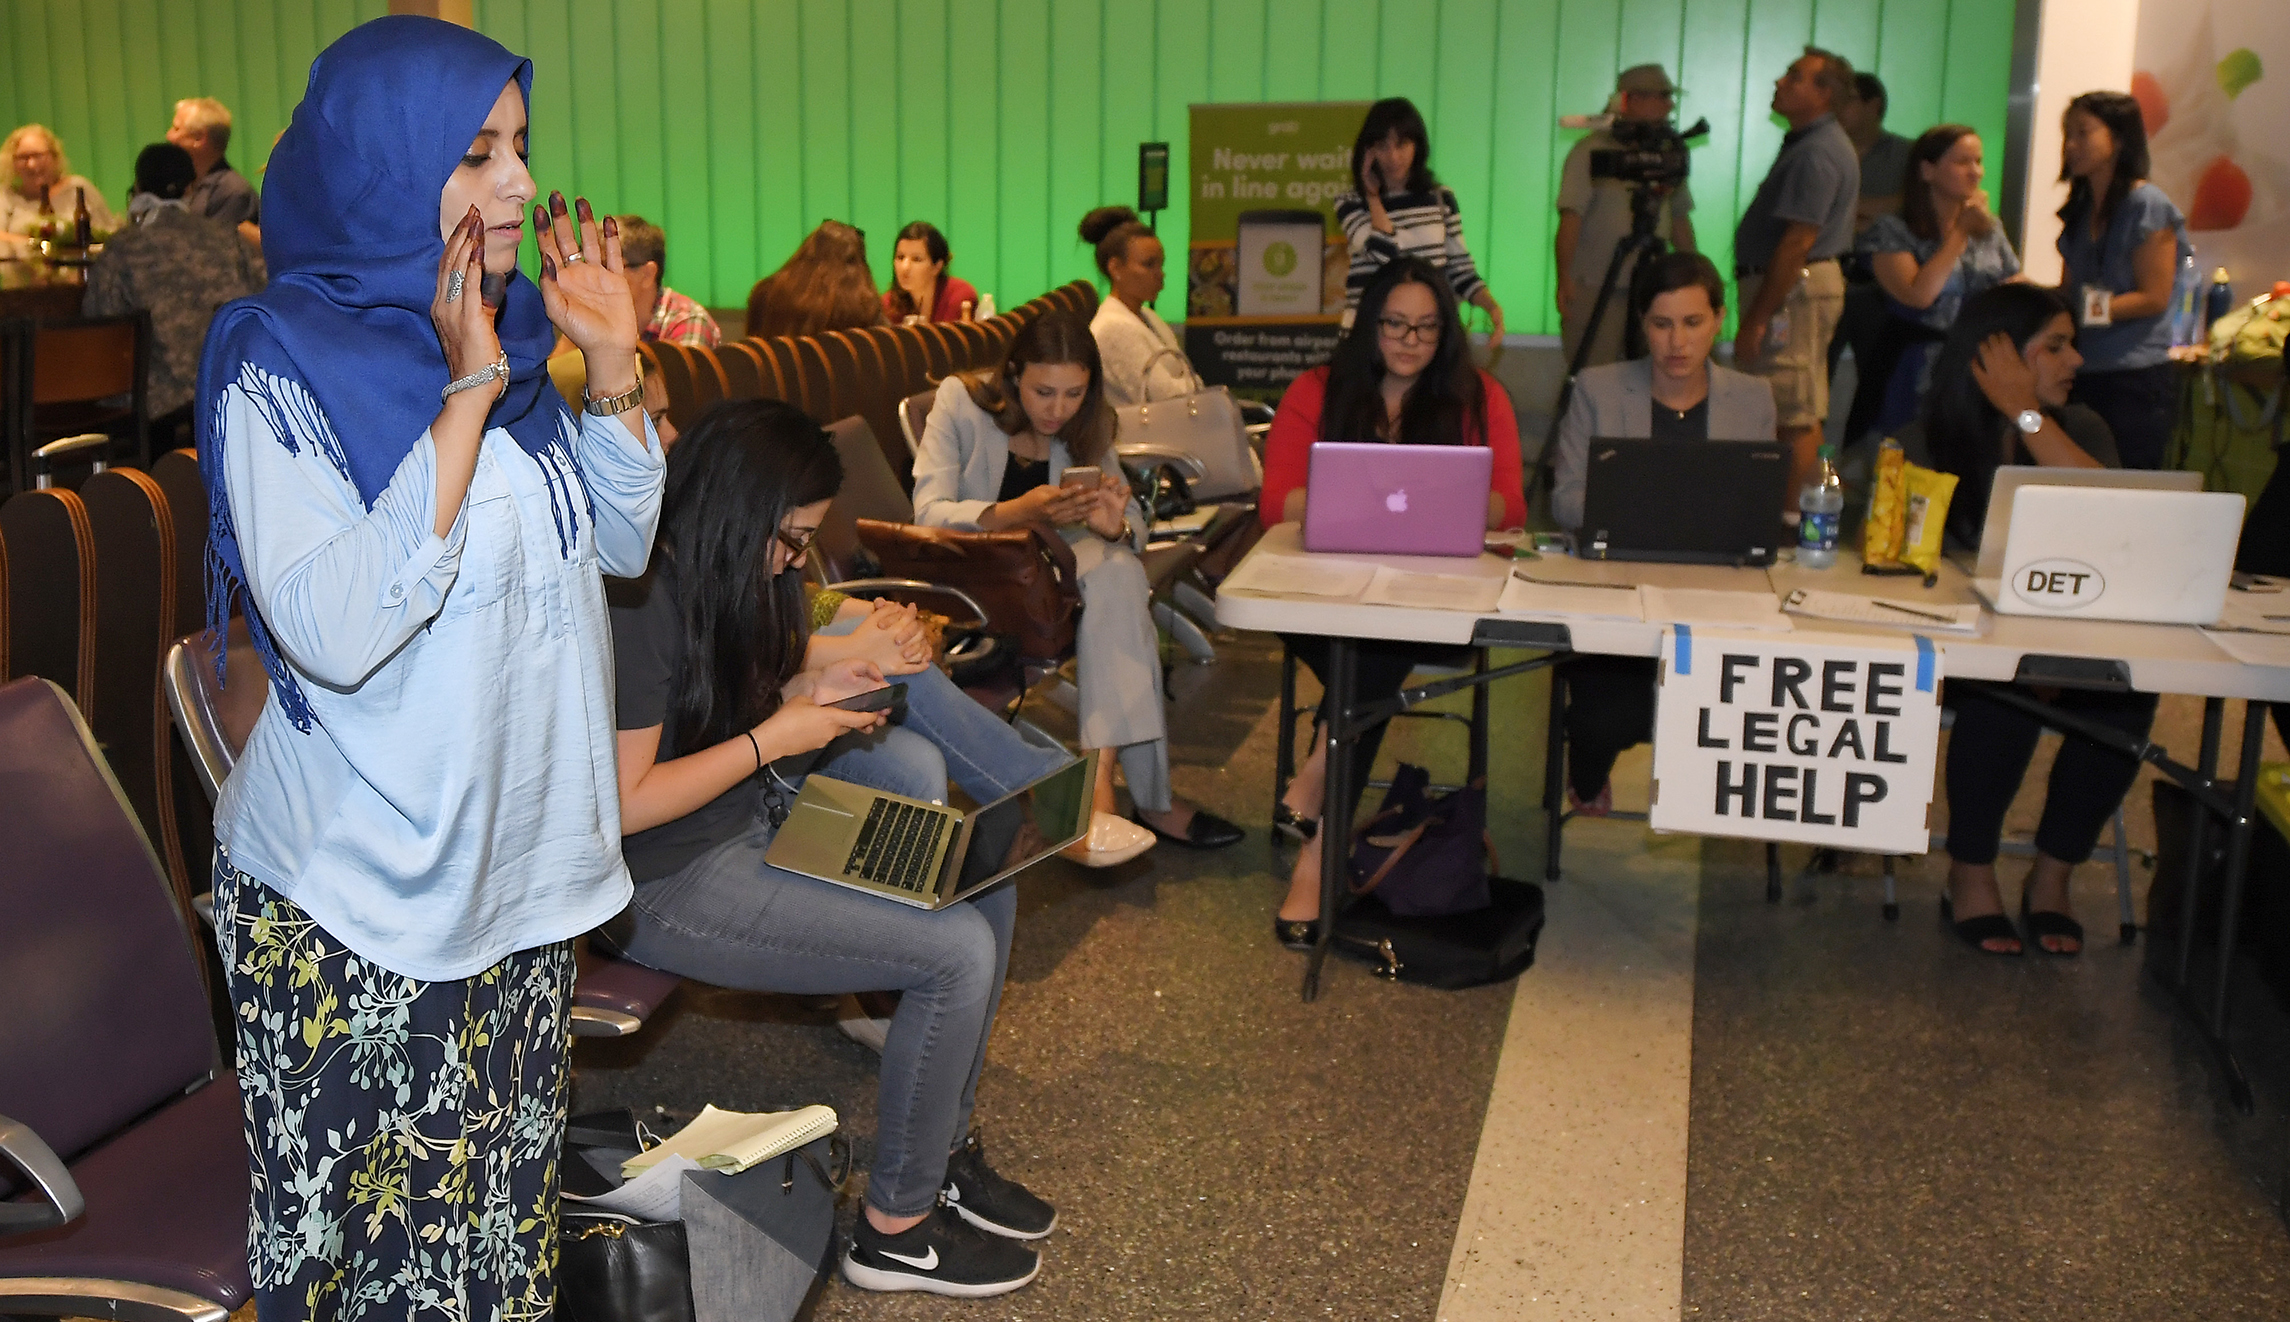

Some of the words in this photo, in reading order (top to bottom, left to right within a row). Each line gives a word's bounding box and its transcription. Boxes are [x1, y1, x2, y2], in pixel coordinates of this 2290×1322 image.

[1213, 147, 1290, 170] Never
[1201, 175, 1225, 199] in
[1233, 175, 1278, 199] line
[1213, 330, 1255, 346] Order
[1258, 331, 1292, 347] from
[1222, 350, 1302, 363] restaurants
[1237, 368, 1268, 381] your
[2027, 570, 2091, 595] DET
[1720, 653, 1905, 717] FREE
[1697, 706, 1907, 764] LEGAL
[1715, 760, 1889, 828] HELP
